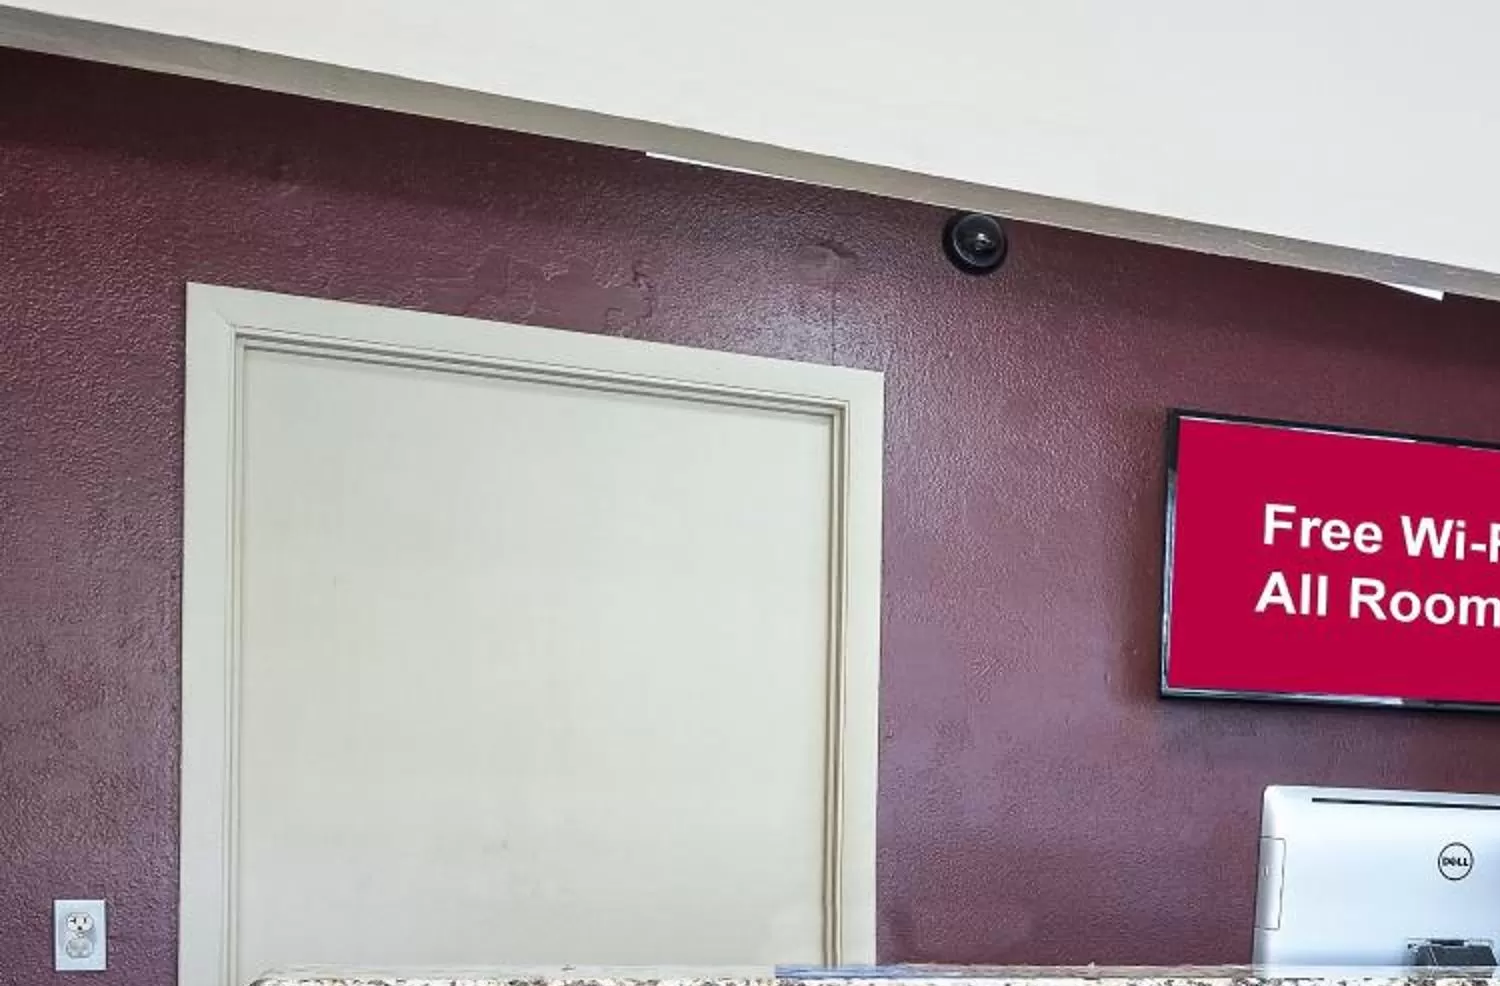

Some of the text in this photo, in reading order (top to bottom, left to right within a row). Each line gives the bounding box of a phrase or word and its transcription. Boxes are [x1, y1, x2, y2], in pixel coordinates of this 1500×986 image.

[1263, 503, 1383, 554] Free
[1255, 571, 1329, 617] All
[1442, 857, 1468, 867] DELL
